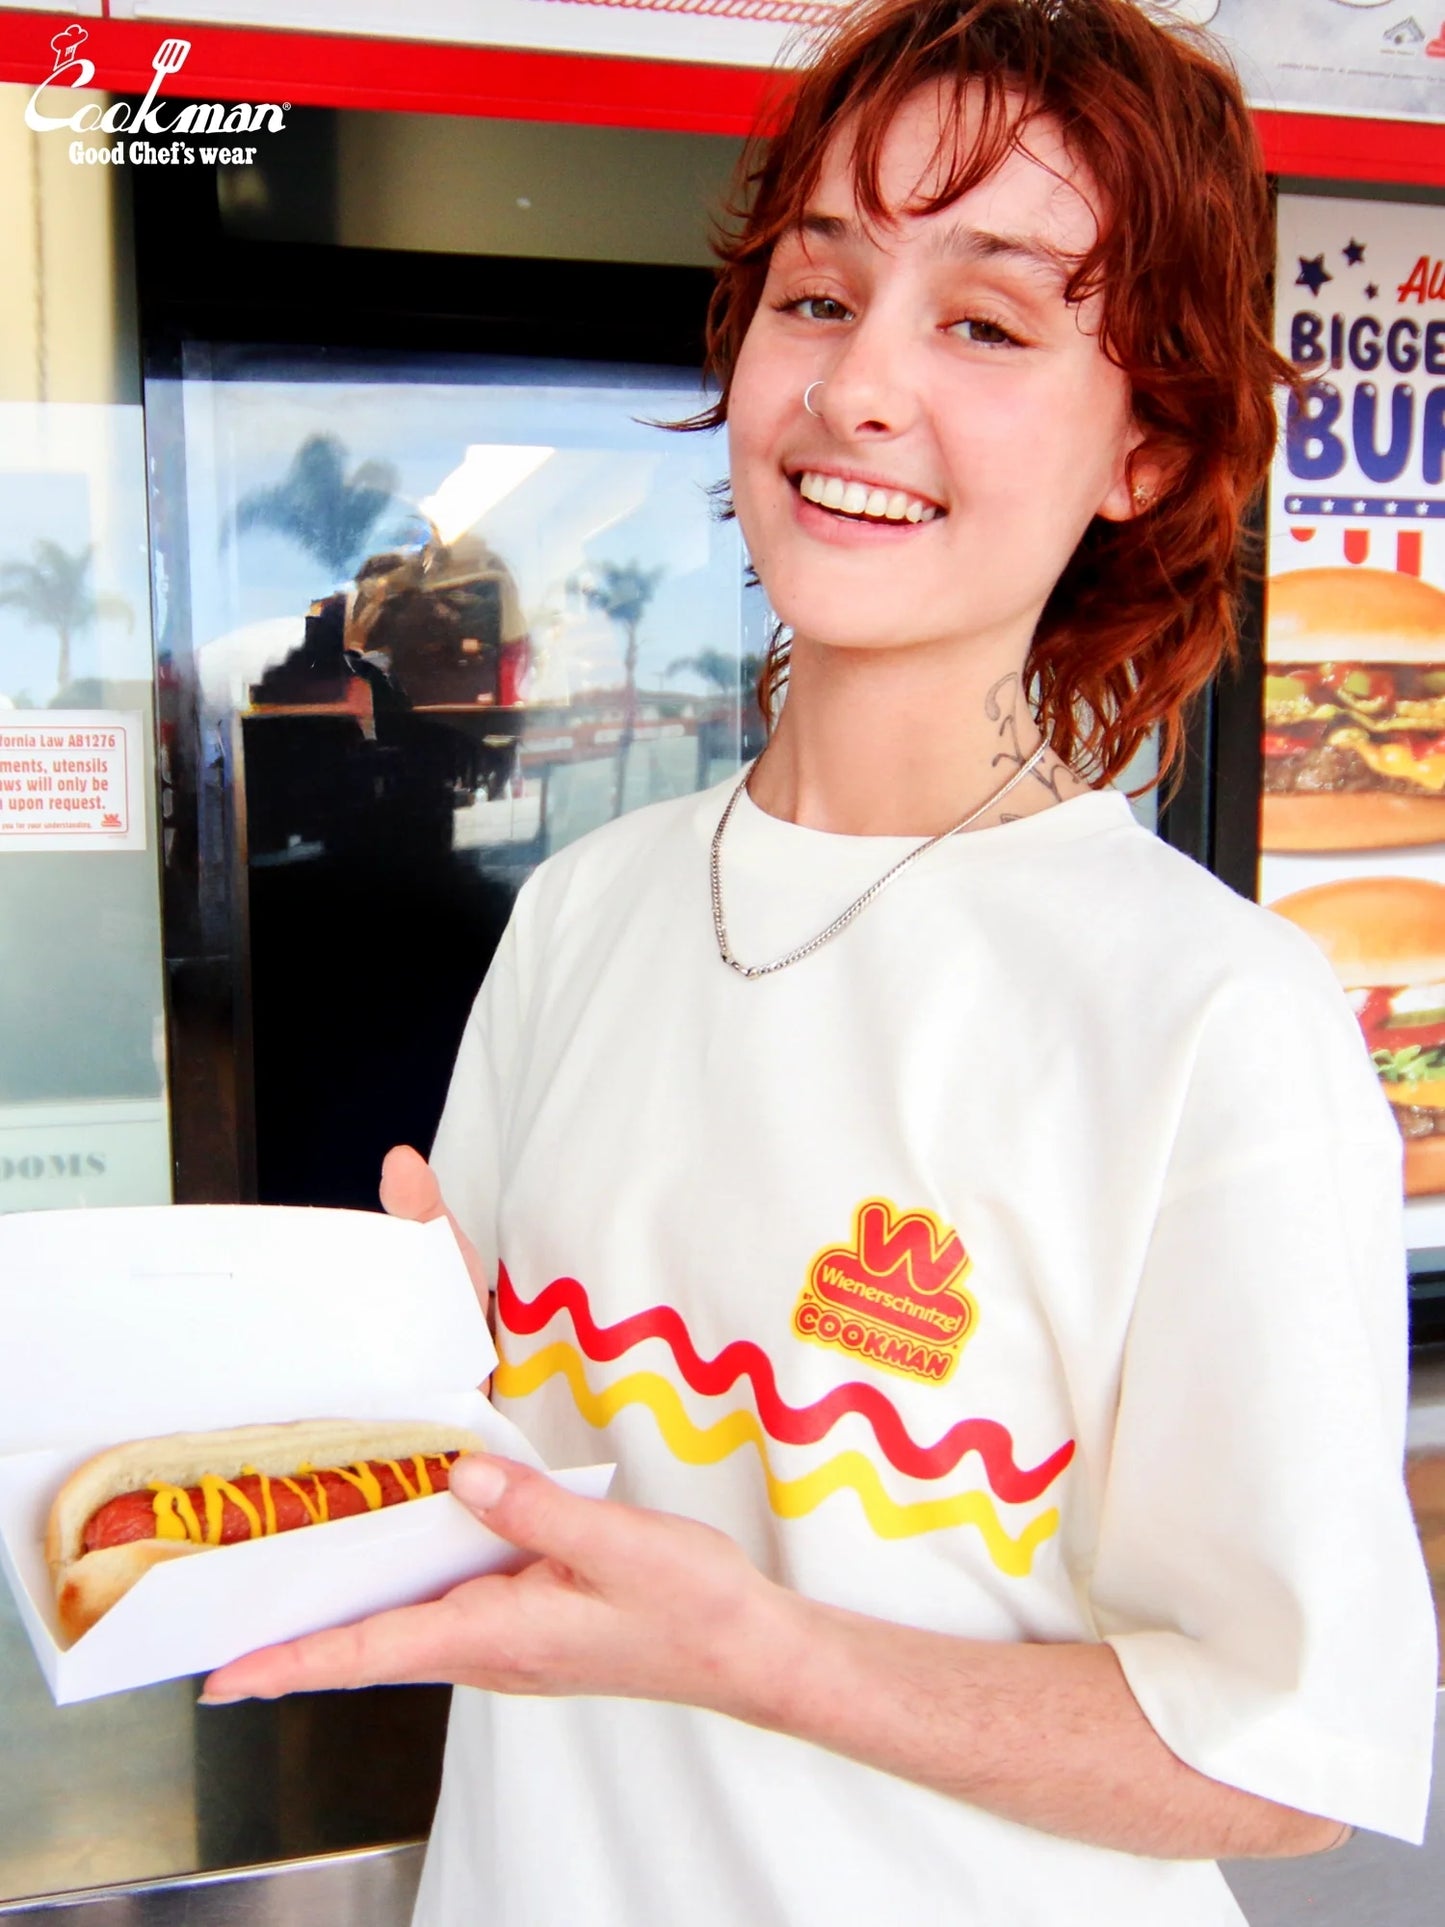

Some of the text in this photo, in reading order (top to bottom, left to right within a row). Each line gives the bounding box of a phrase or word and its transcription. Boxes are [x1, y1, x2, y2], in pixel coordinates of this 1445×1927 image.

[40, 734, 64, 748] Law
[68, 734, 116, 748] AB1276
[52, 758, 108, 773] utensils
[27, 776, 52, 791] will
[57, 777, 87, 793] only
[92, 776, 109, 791] be
[9, 797, 106, 811] upon request.
[821, 1264, 963, 1334] Wienerschnitzel
[796, 1303, 952, 1380] COOKMAN
